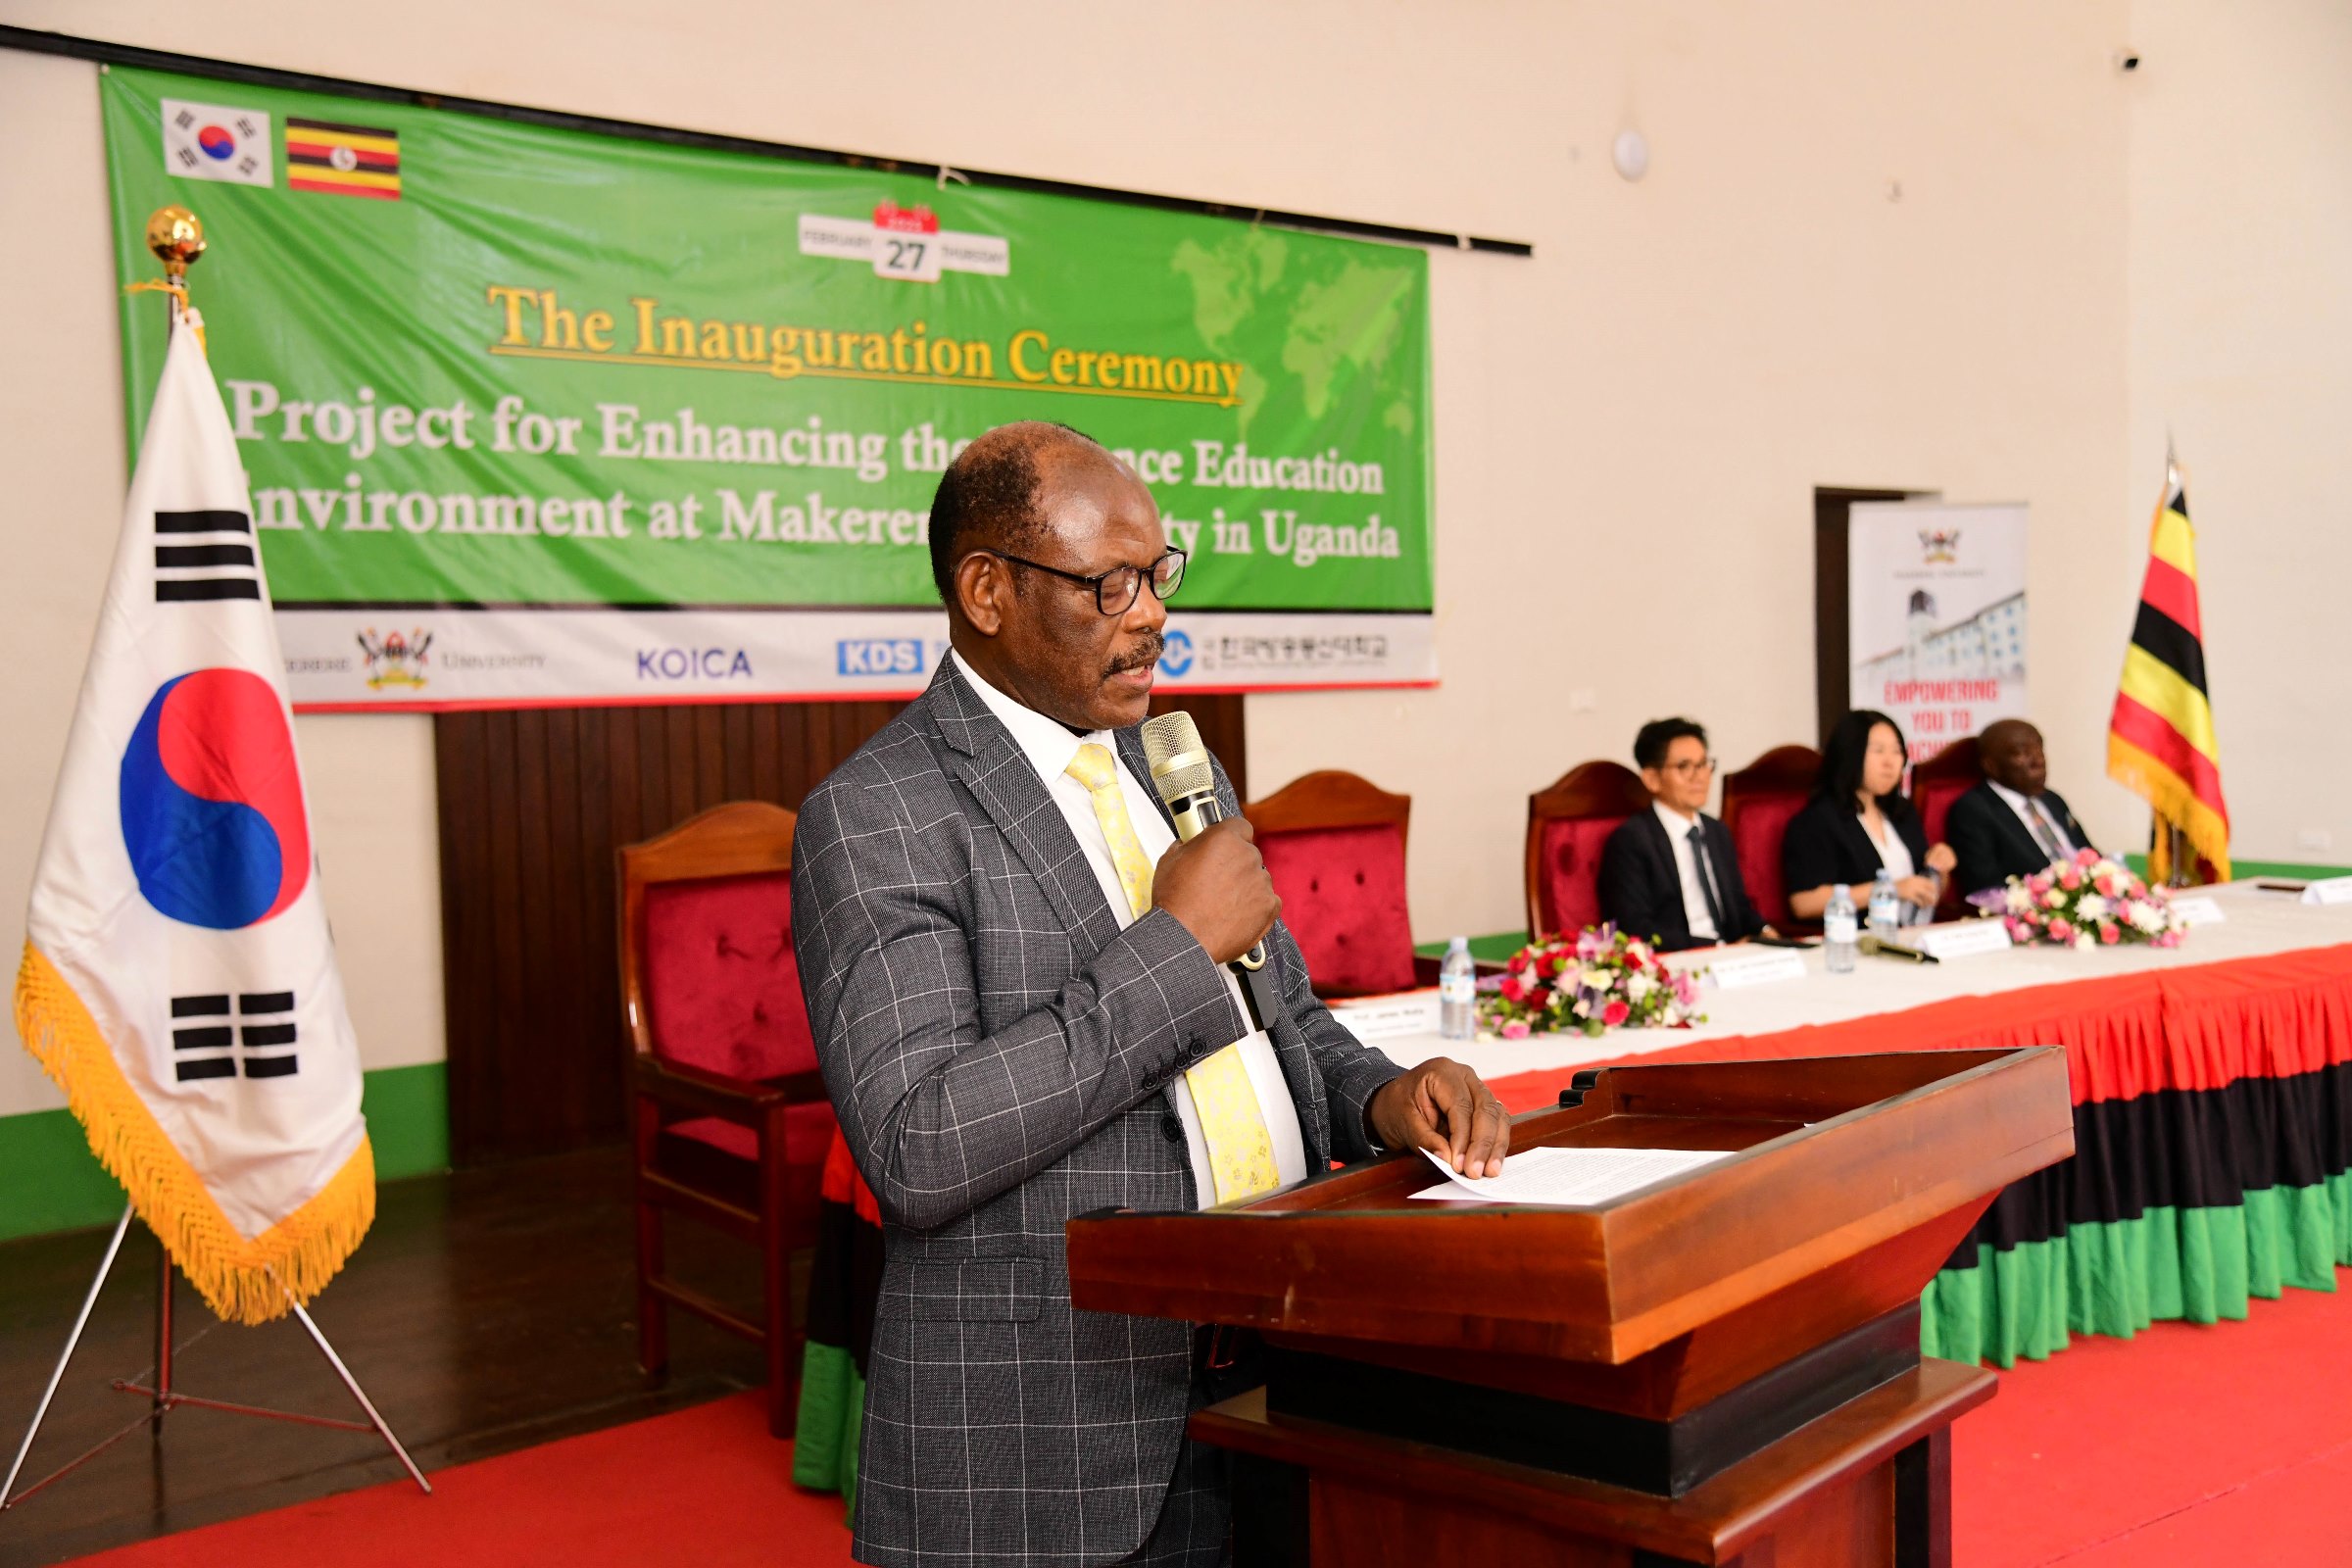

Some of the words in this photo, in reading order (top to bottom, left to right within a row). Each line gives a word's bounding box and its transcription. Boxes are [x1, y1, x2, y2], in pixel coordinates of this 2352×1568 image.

[886, 240, 925, 271] 27
[487, 284, 615, 353] The
[629, 297, 994, 380] Inauguration
[1007, 329, 1243, 408] Ceremony
[224, 379, 475, 460] Project
[491, 394, 583, 456] for
[596, 402, 889, 483] Enhancing
[1191, 440, 1385, 495] Education
[246, 470, 632, 539] nvironment
[647, 492, 704, 541] at
[714, 488, 931, 546] Makerer
[1212, 508, 1253, 555] in
[1260, 510, 1401, 567] Uganda
[637, 648, 753, 679] KOICA
[844, 641, 919, 673] KDS
[1884, 678, 2000, 703] EMPOWERING
[1911, 711, 1944, 734] YOU
[1951, 710, 1973, 733] TO
